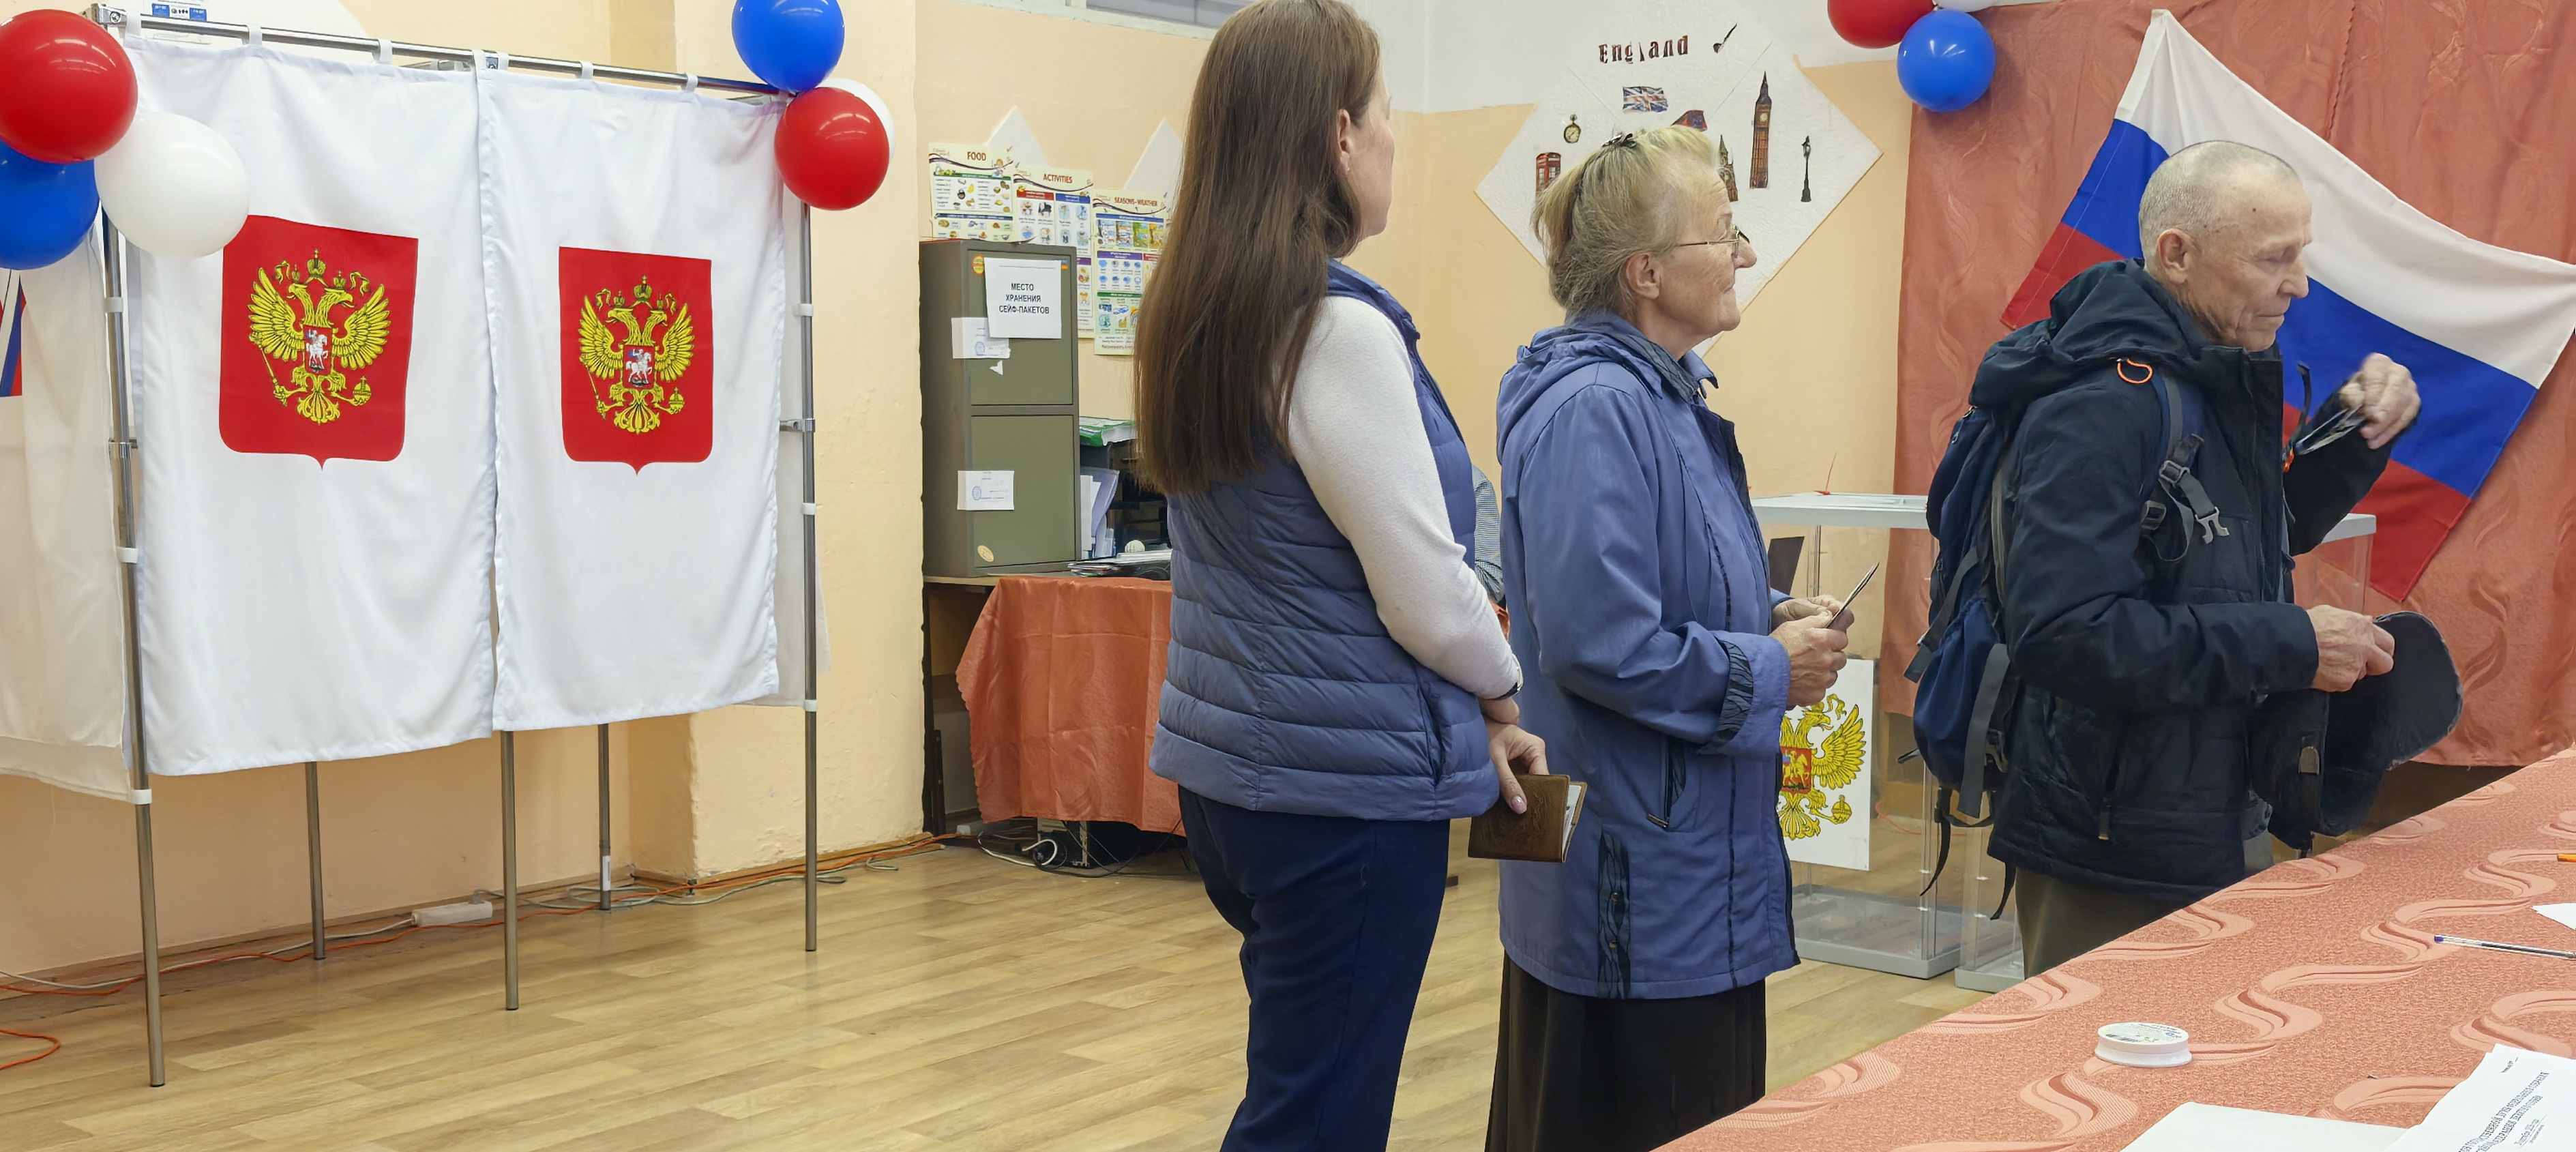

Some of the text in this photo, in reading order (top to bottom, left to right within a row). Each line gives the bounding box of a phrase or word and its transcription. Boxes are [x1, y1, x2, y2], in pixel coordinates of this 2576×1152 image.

[1598, 35, 1688, 64] England
[967, 151, 986, 161] FOOD
[1043, 173, 1073, 183] ACTIVITIES
[1011, 282, 1034, 291] МЕСТО
[1005, 294, 1041, 303] ХРАНЕНИЯ
[998, 304, 1050, 314] СЕЙФ-ПАКЕТОВ
